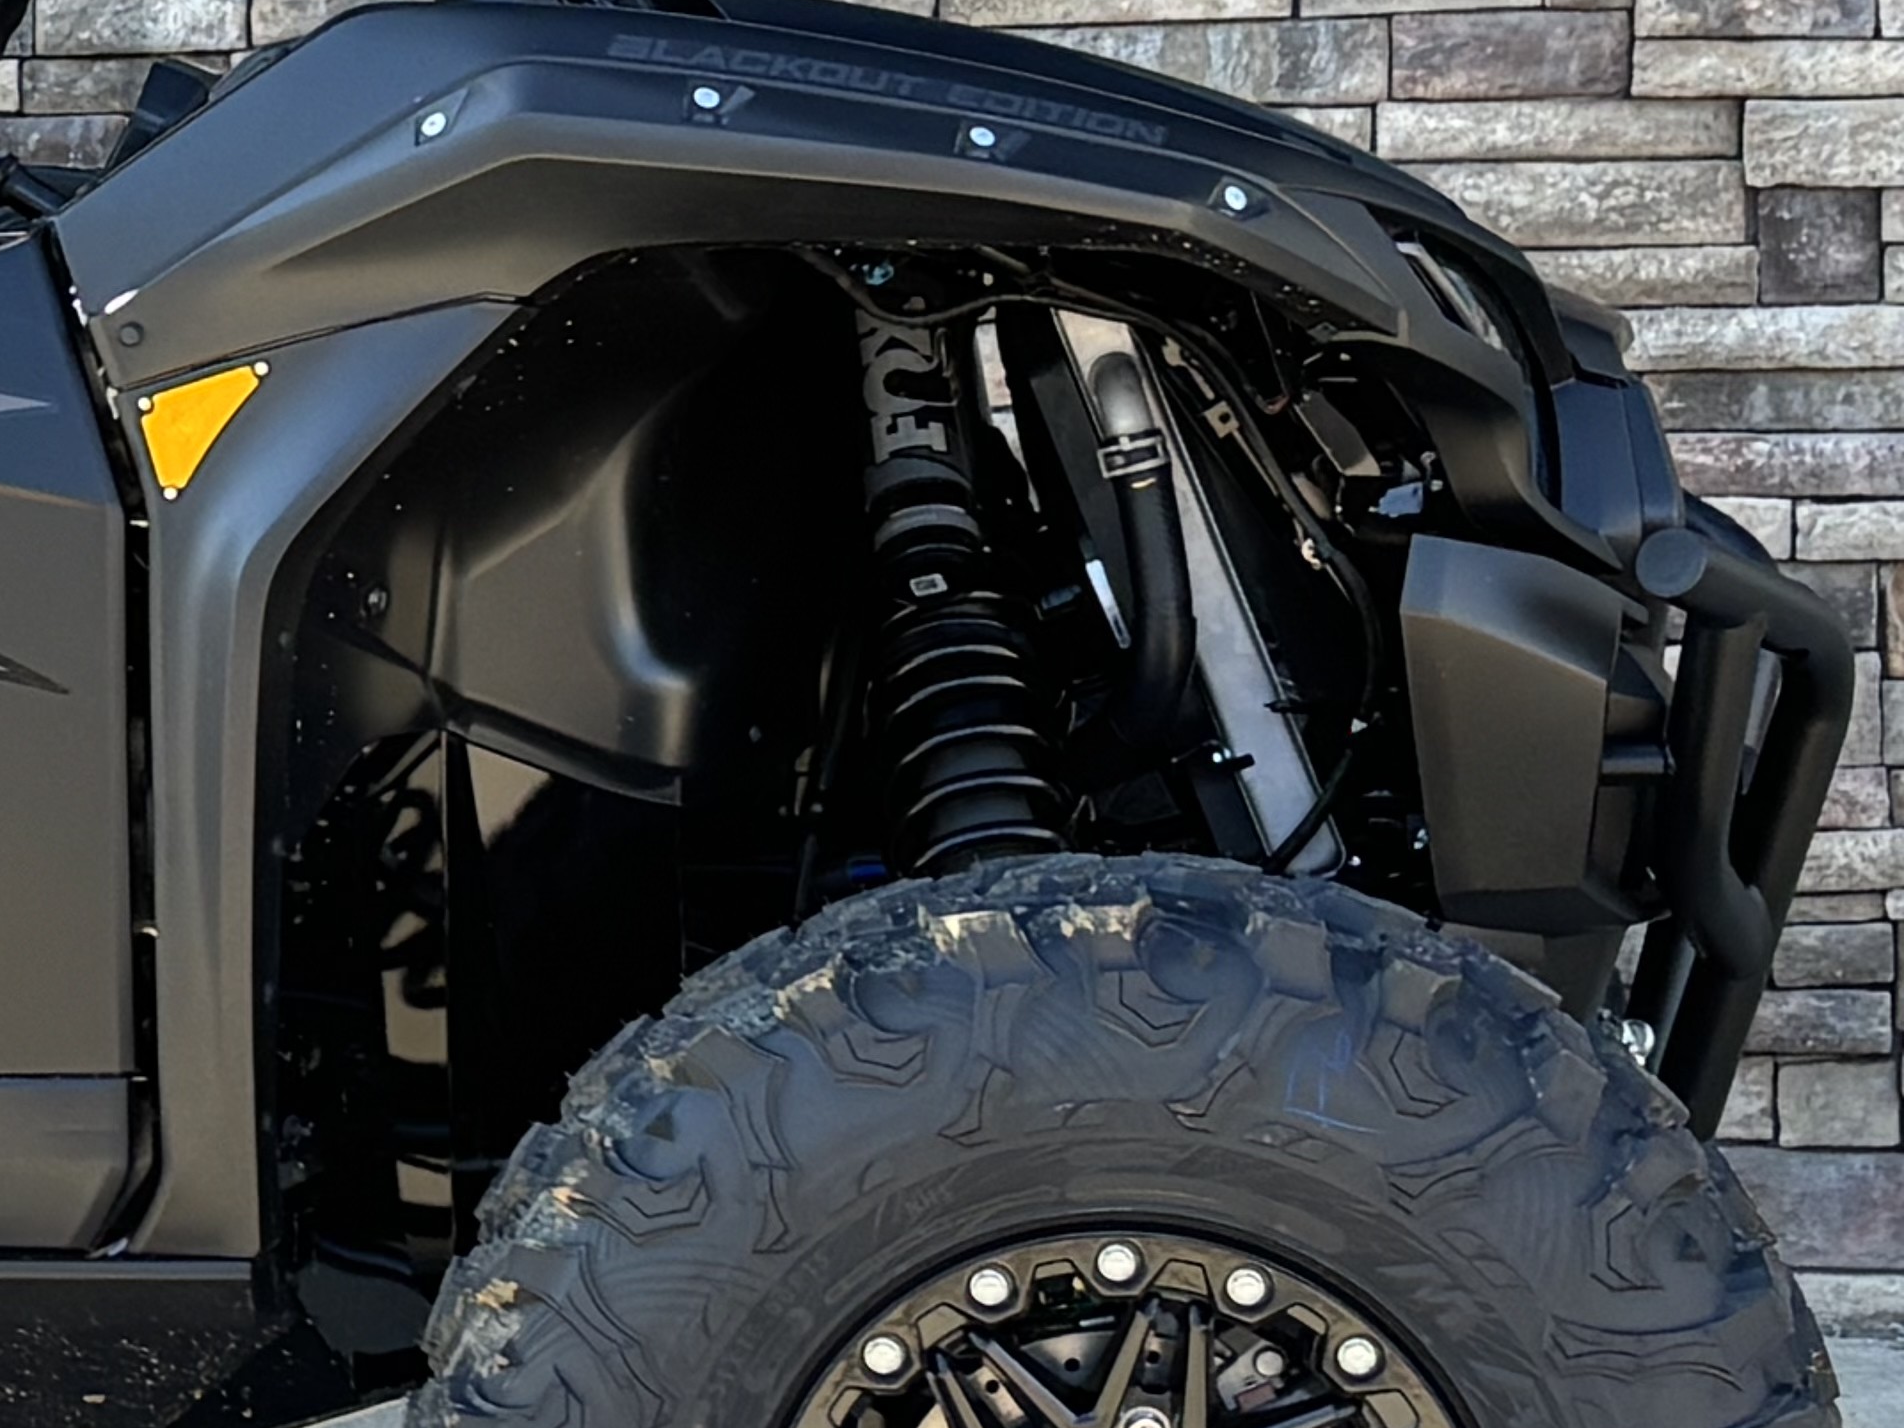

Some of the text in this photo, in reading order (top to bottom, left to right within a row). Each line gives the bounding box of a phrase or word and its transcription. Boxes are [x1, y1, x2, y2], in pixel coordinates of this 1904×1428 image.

[608, 33, 1170, 146] BLACKOUT EDITION
[856, 307, 964, 465] FOX
